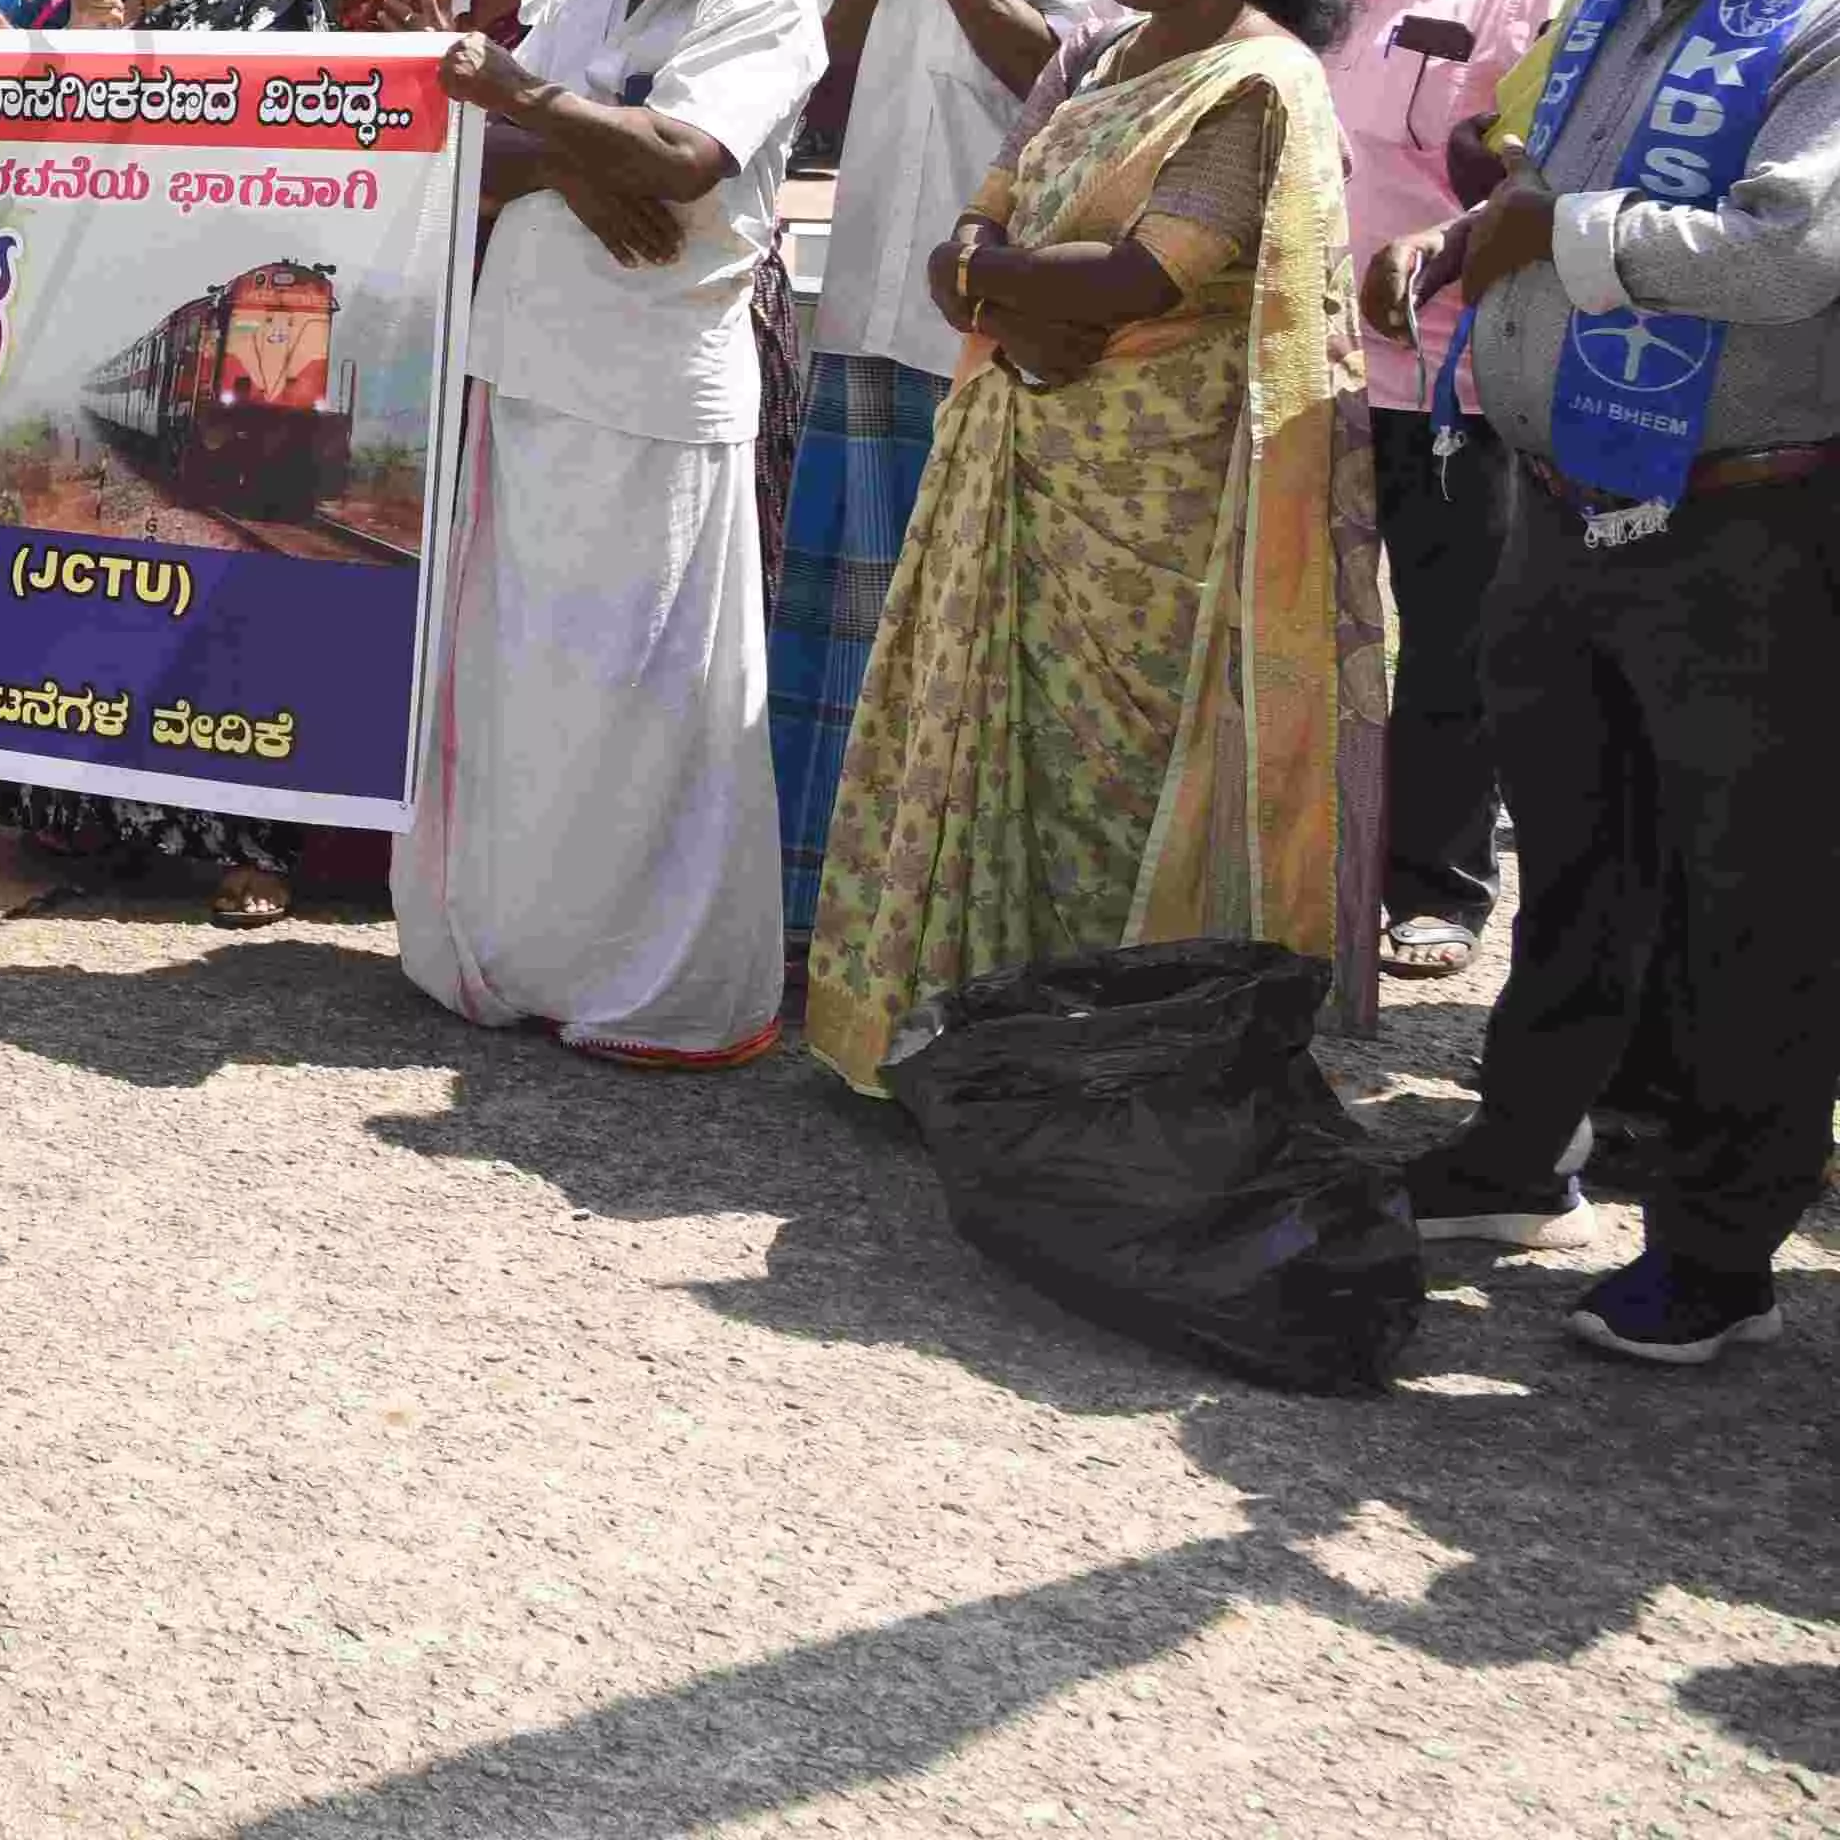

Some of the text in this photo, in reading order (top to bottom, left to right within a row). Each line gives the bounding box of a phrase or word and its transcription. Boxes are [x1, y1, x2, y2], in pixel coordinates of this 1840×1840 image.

[168, 165, 378, 214] ಭಾಗವಾಗಿ
[1568, 393, 1689, 436] JAI BHEEM
[11, 546, 192, 616] (JCTU)
[152, 698, 296, 760] ವೇದಿಕೆ
